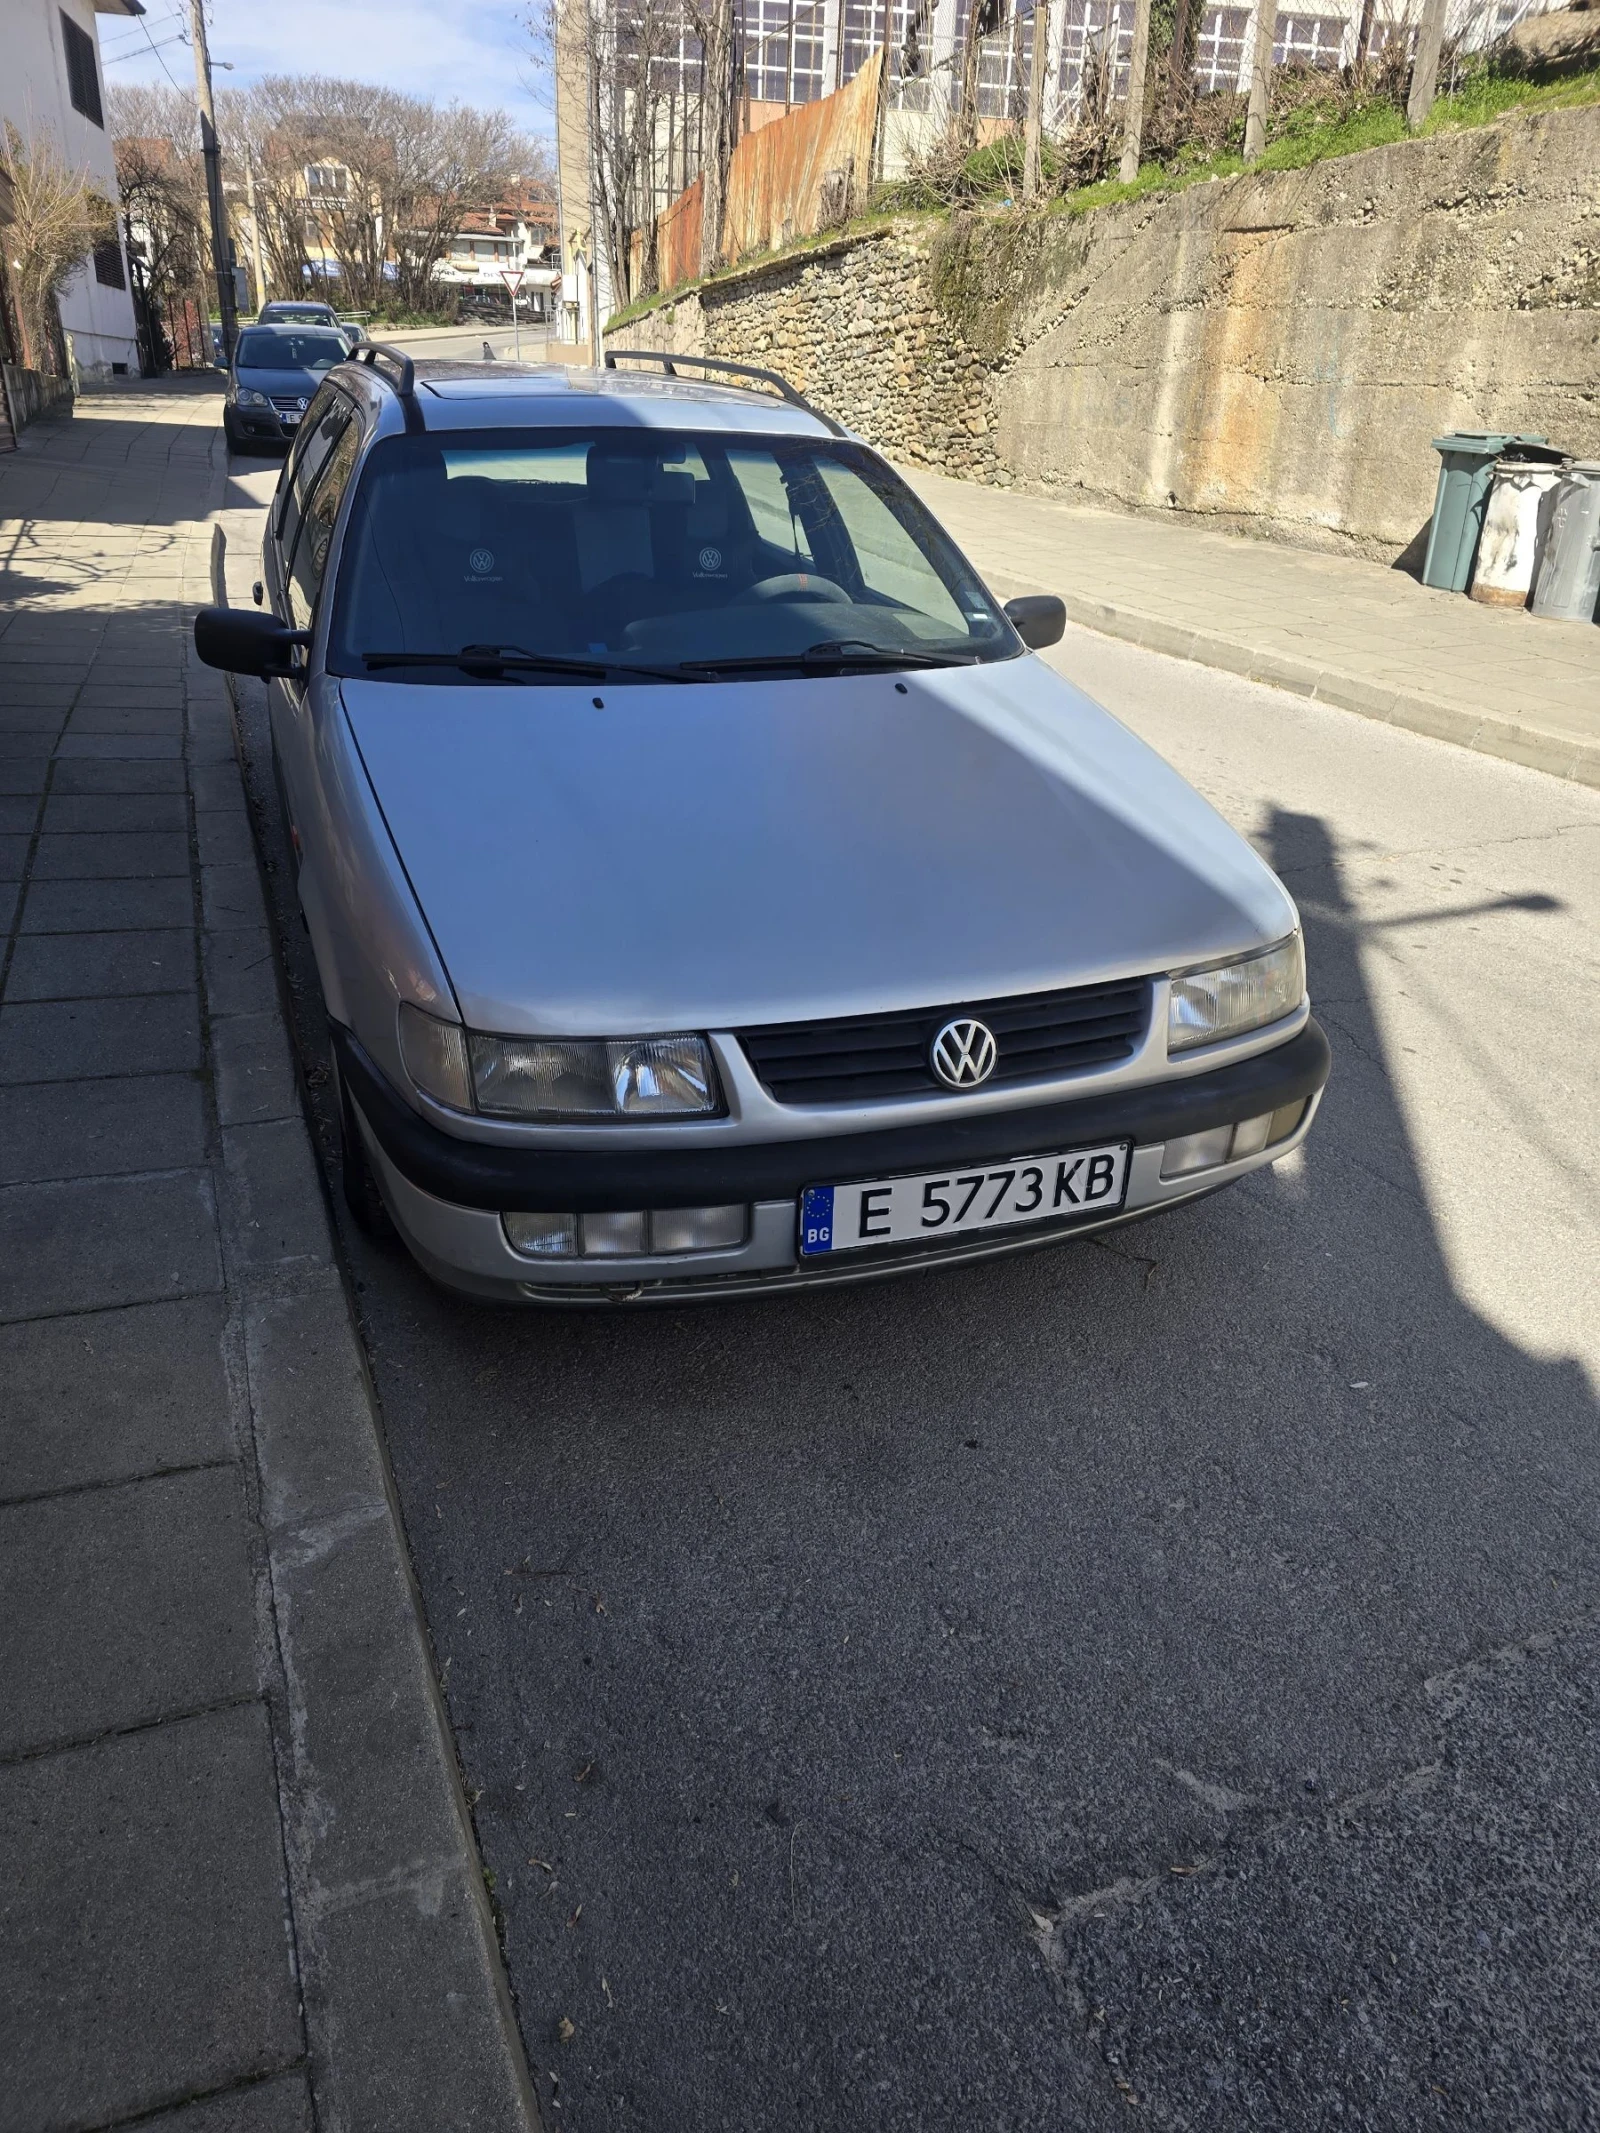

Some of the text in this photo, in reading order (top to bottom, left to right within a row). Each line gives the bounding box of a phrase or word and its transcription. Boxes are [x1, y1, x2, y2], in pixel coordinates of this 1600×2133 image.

[933, 1019, 997, 1088] VW
[807, 1227, 830, 1244] BG
[858, 1187, 893, 1239] E
